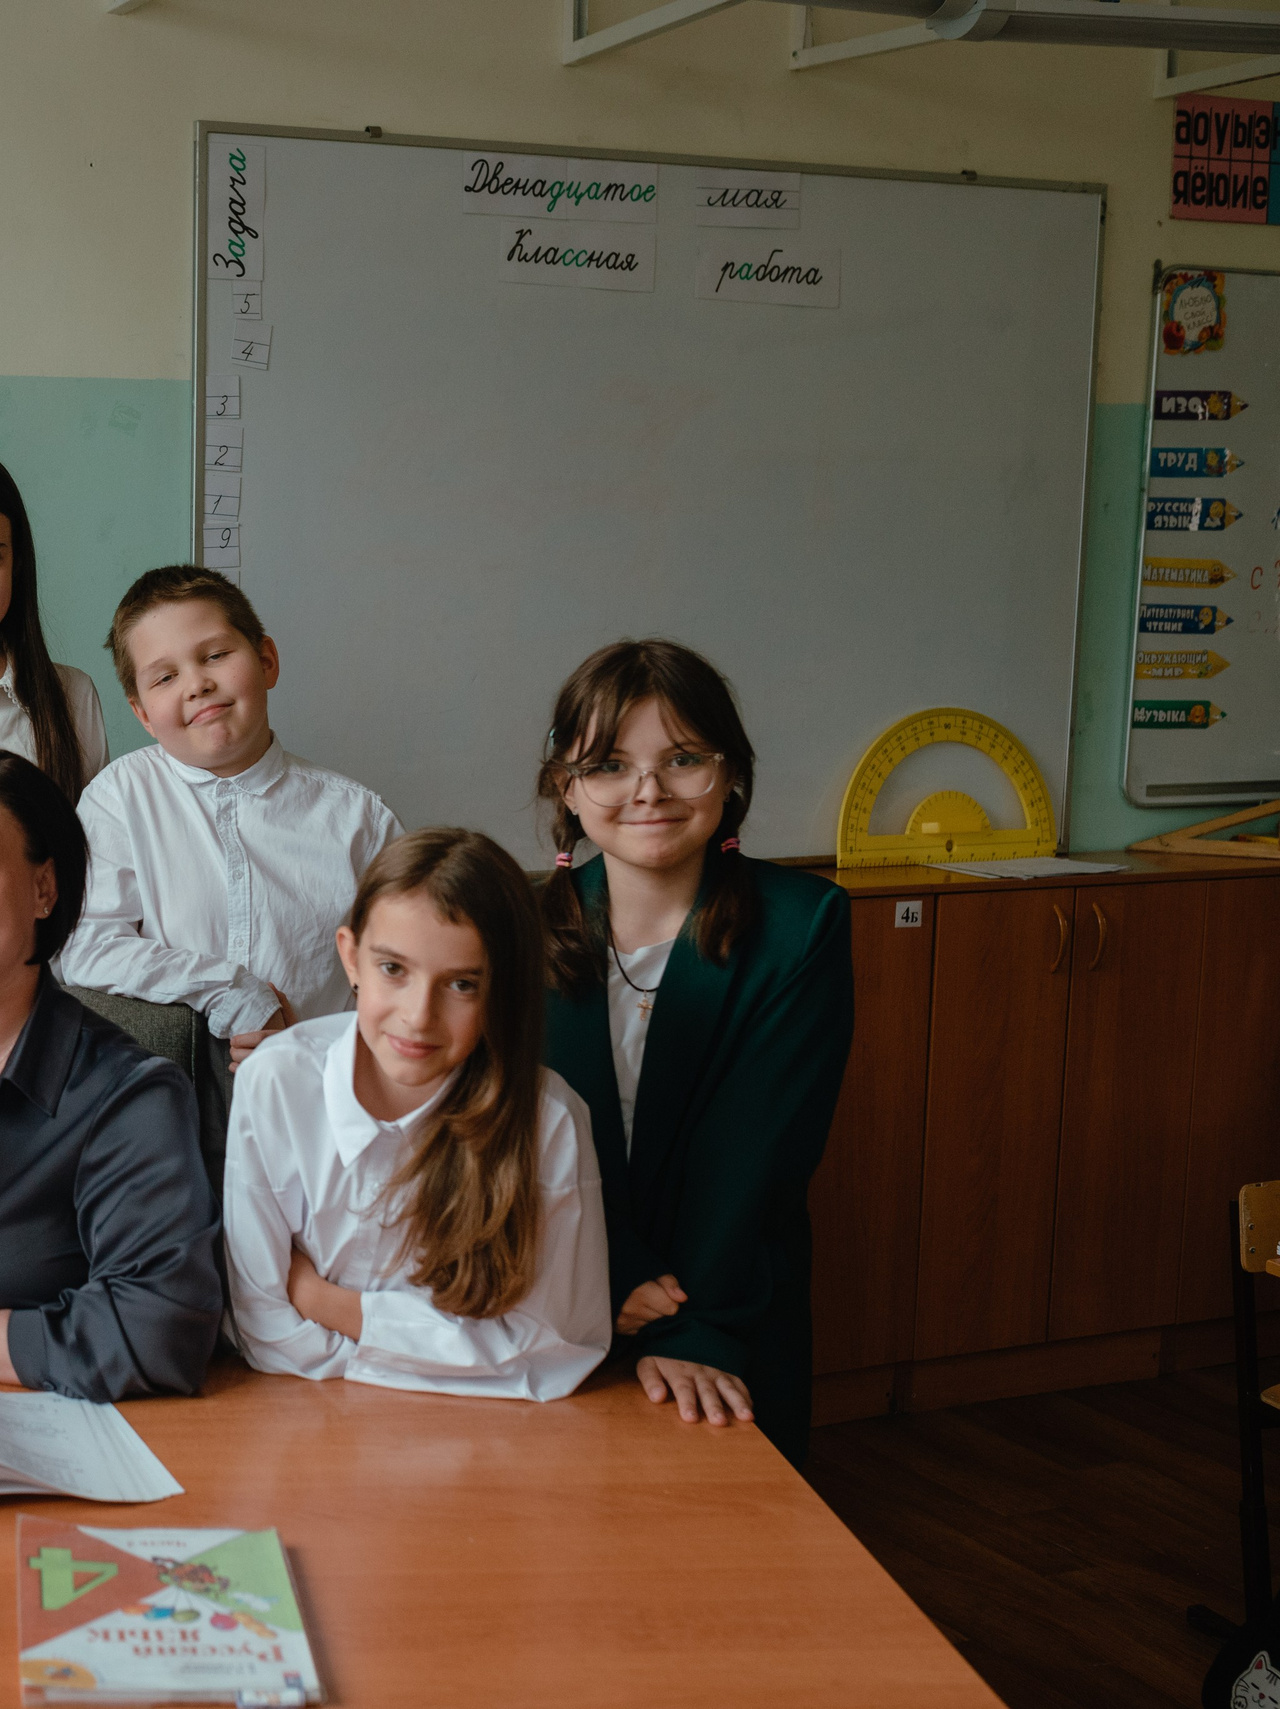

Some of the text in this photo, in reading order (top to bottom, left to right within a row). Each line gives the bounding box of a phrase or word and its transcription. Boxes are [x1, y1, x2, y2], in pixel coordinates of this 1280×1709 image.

[464, 159, 787, 213] Двенадцатое мая
[213, 148, 259, 277] Задача
[507, 228, 823, 293] Классная работа
[240, 293, 253, 314] 5
[241, 341, 254, 362] 4
[216, 395, 227, 416] 3
[1161, 396, 1203, 413] ИЗО
[214, 445, 229, 467] 2
[1158, 451, 1198, 471] ТРУД
[211, 495, 222, 515] 1
[219, 527, 232, 549] 9
[28, 1547, 119, 1610] 4
